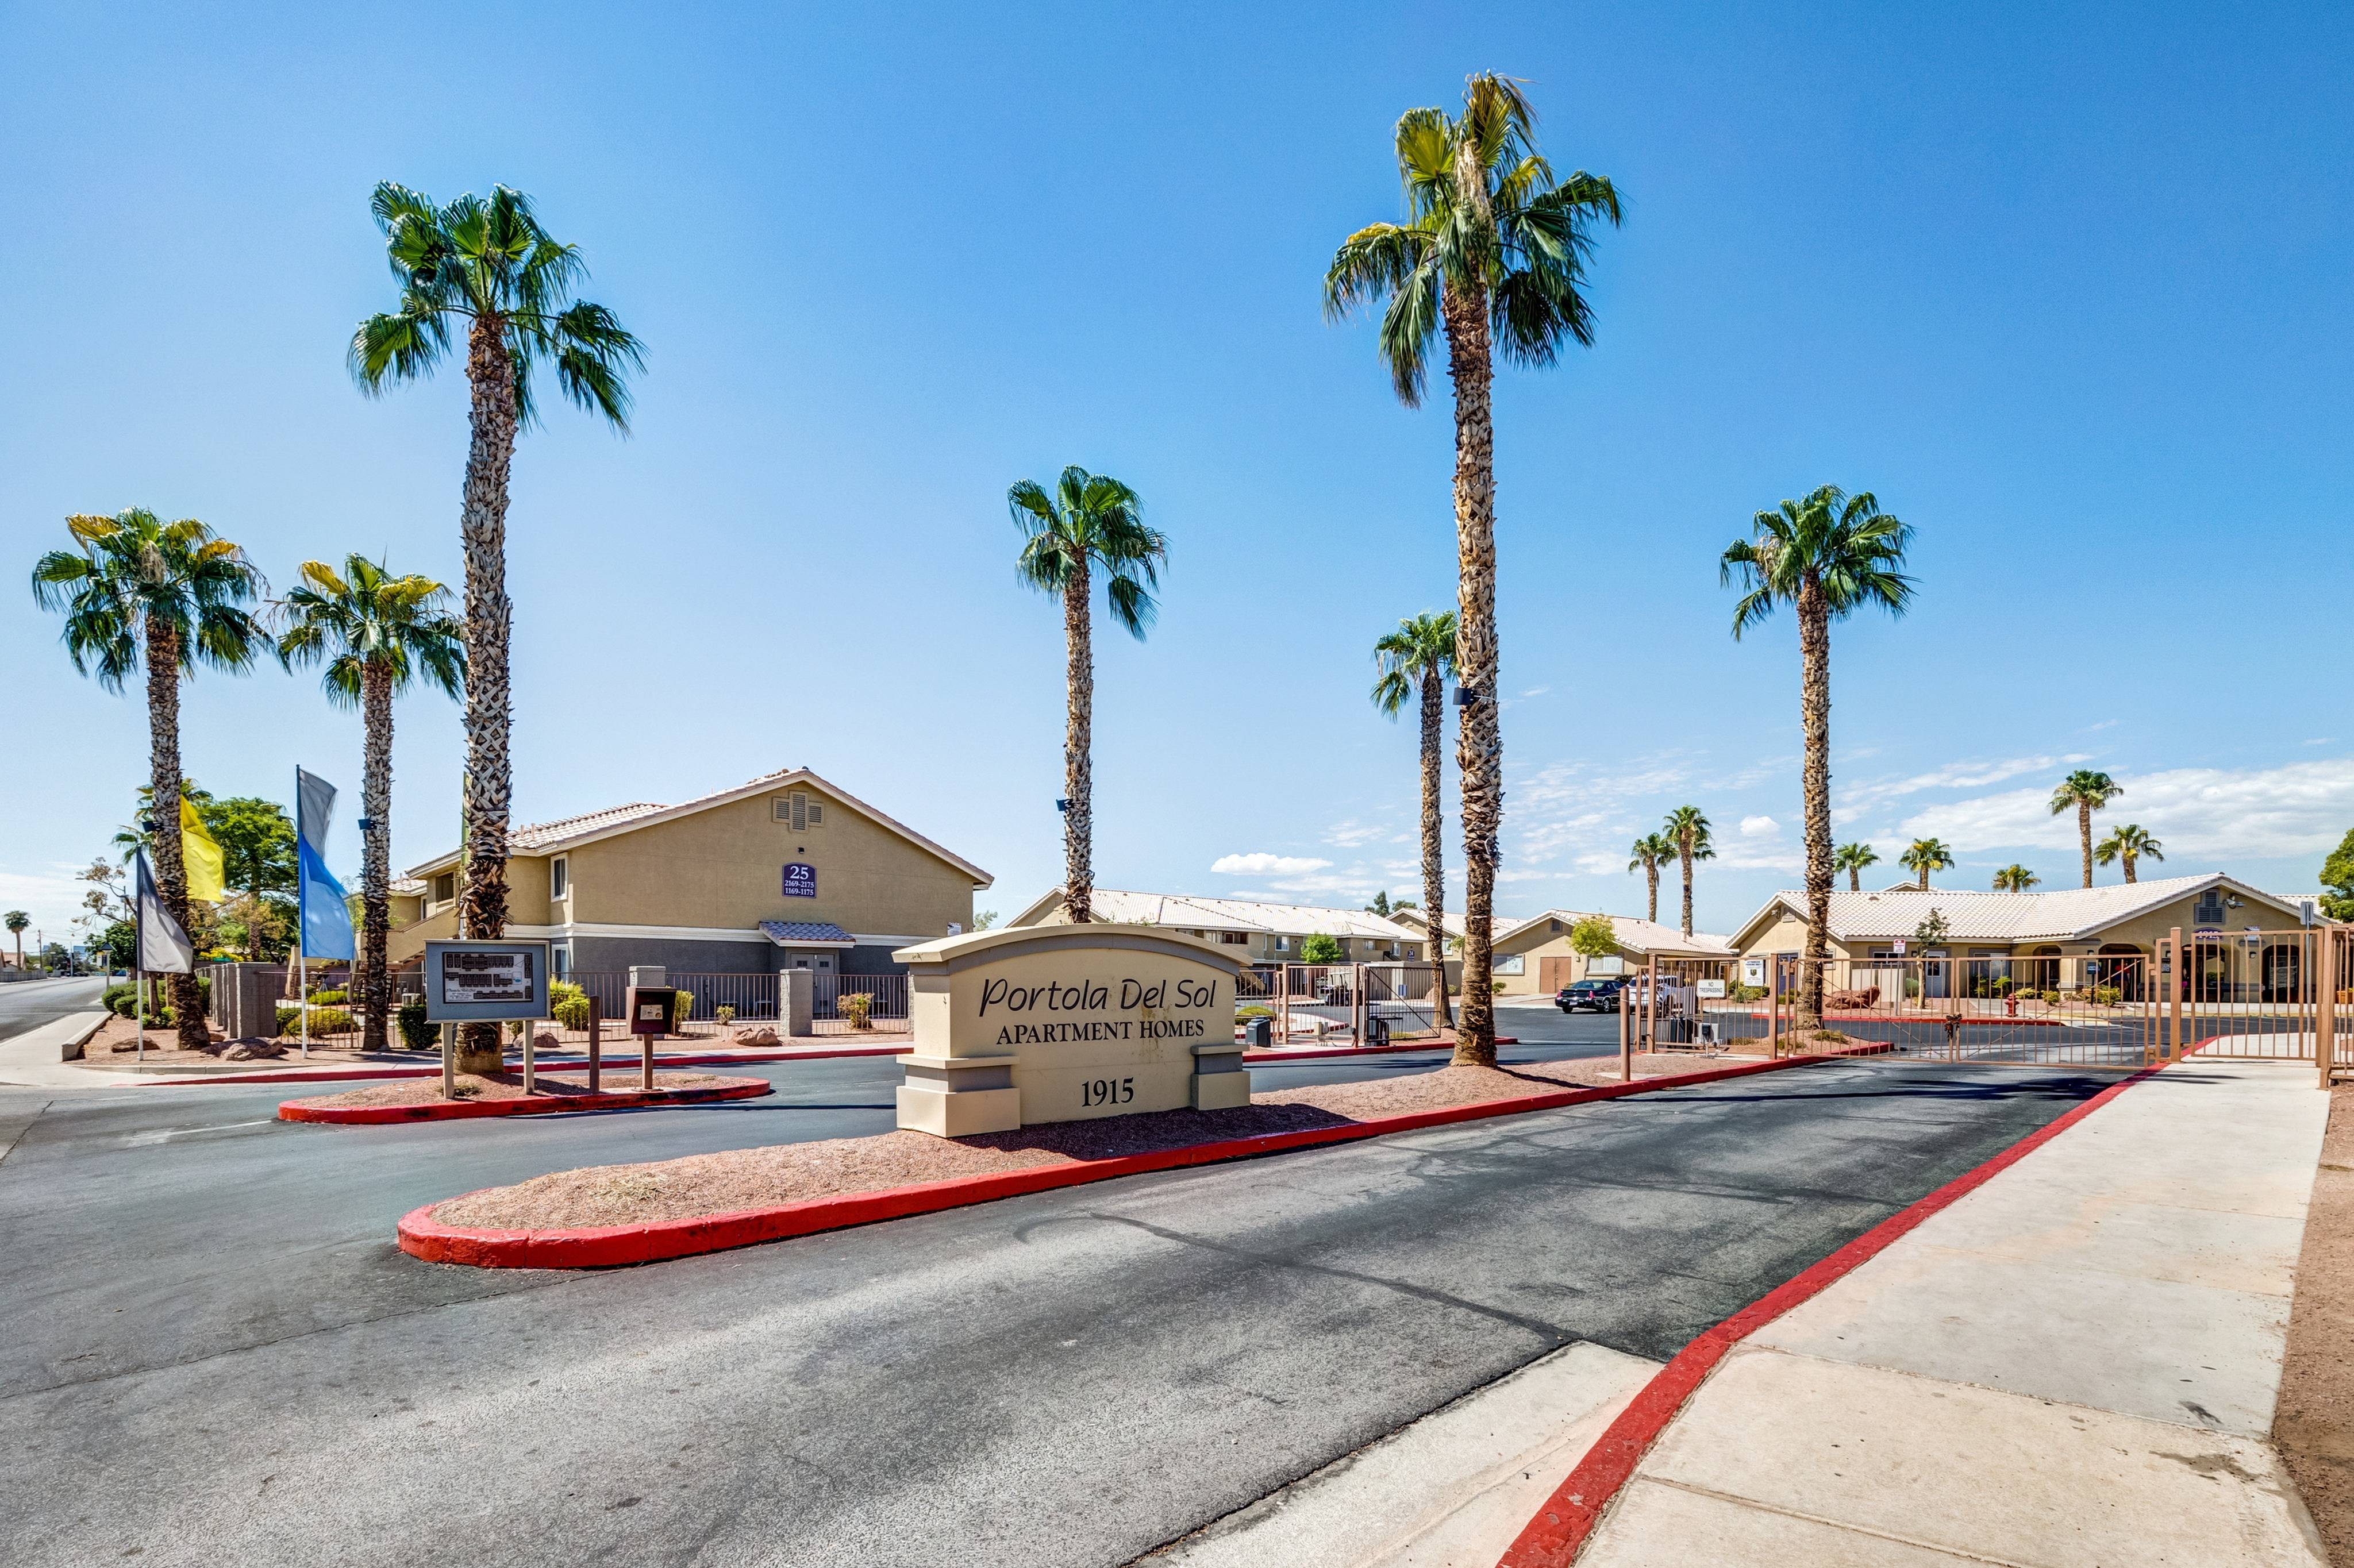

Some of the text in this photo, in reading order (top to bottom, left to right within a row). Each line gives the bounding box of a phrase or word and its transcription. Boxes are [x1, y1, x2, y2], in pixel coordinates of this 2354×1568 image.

[784, 880, 814, 888] 2169-2175
[790, 866, 809, 880] 25
[979, 978, 1216, 1017] Portola Del Sol
[996, 1019, 1204, 1045] APARTMENT HOMES
[1082, 1077, 1134, 1107] 1915
